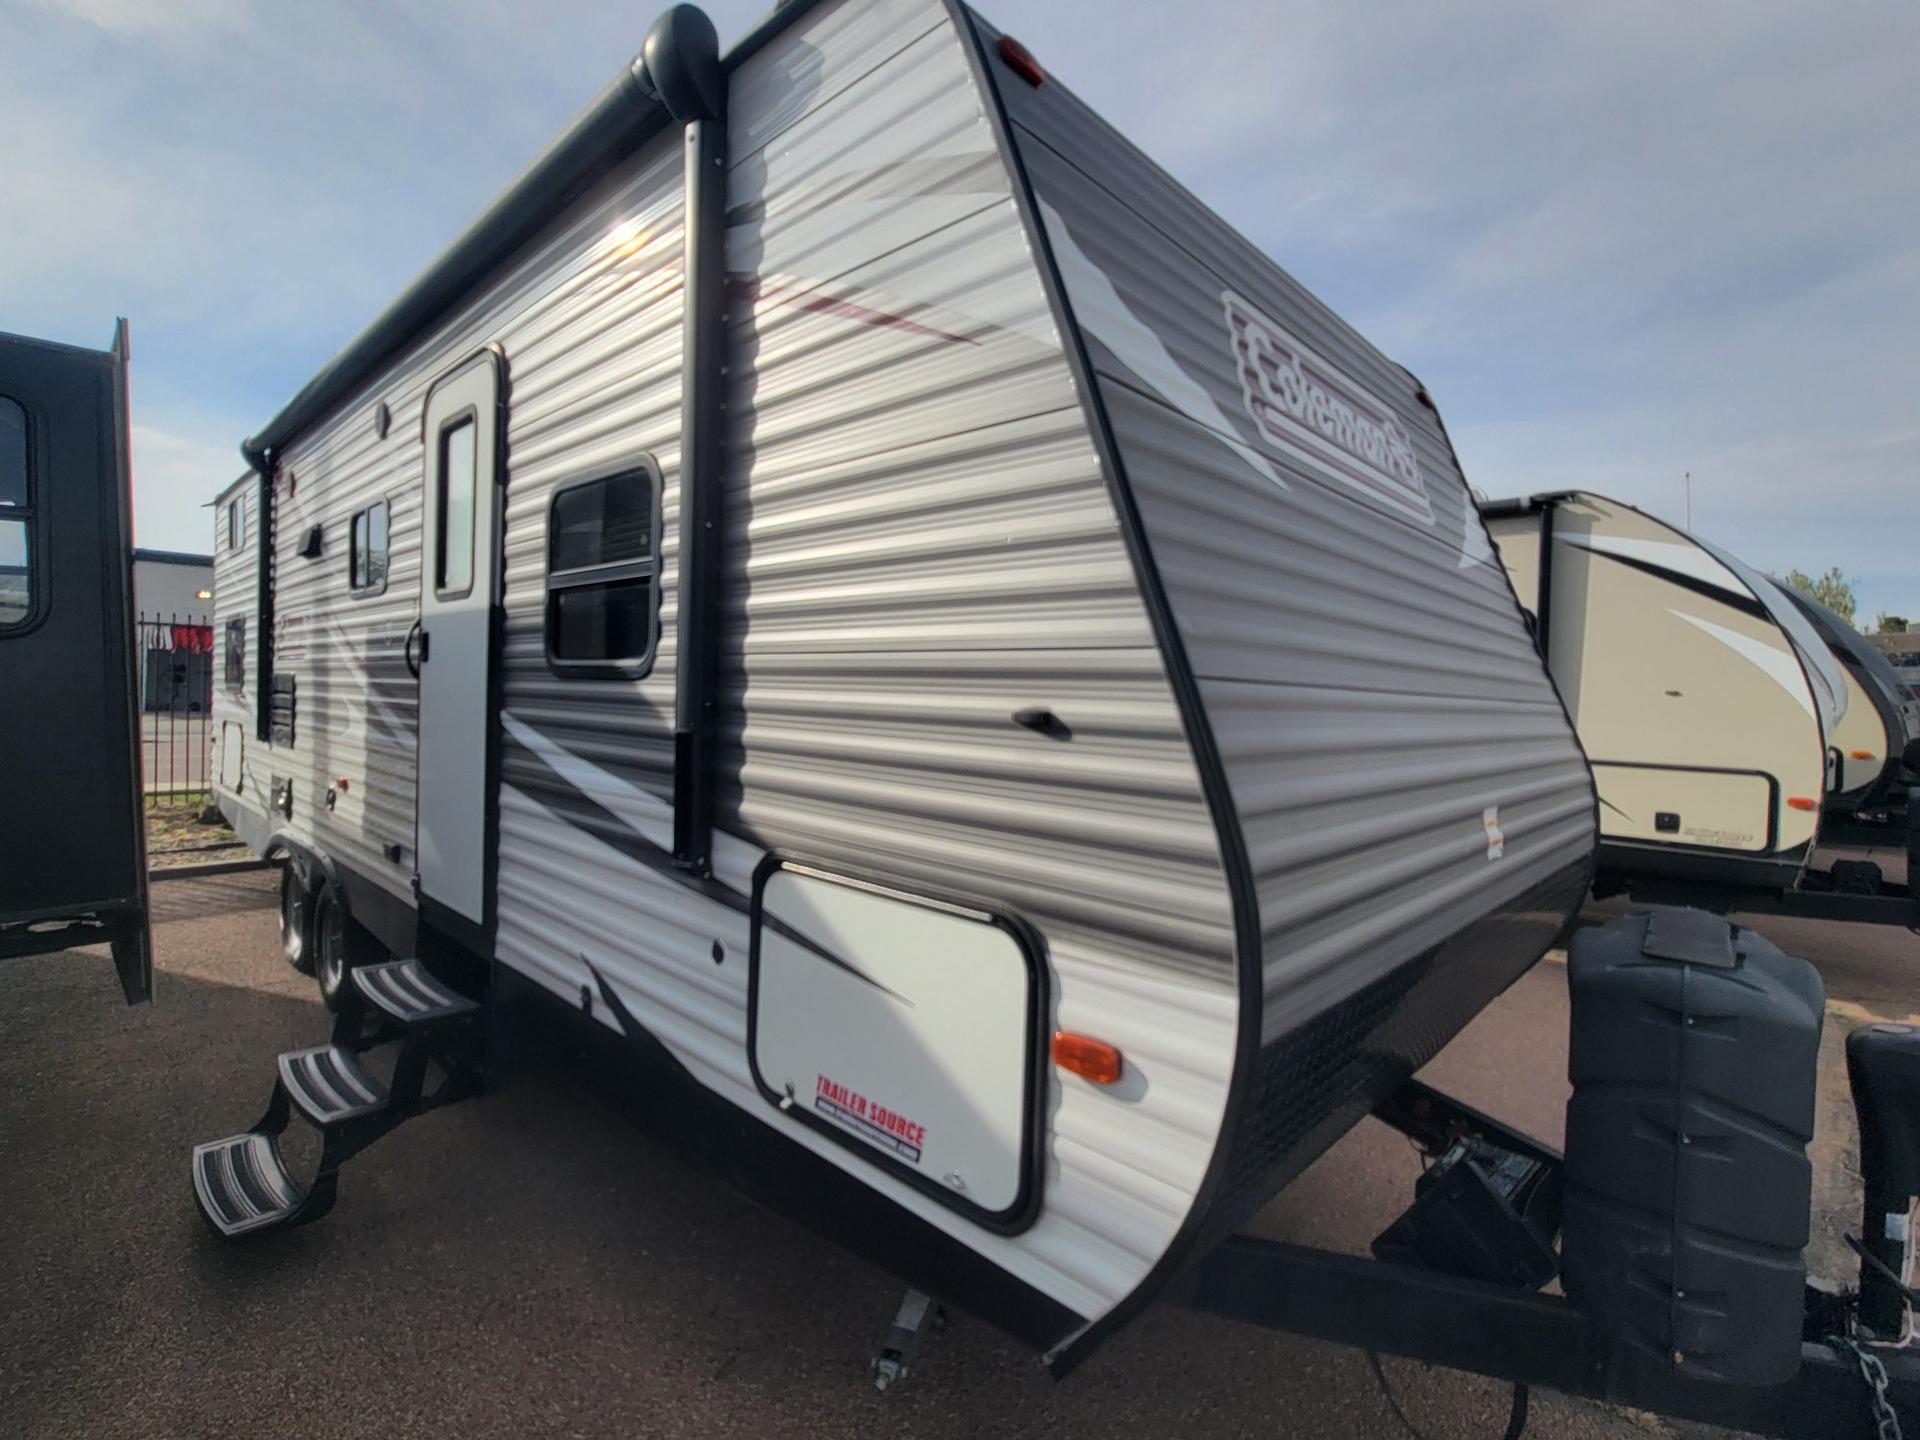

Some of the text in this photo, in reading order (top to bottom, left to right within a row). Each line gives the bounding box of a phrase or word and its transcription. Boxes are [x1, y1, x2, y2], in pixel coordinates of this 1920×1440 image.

[1245, 321, 1396, 477] Coleman
[816, 1075, 927, 1145] TRAILER SOURCE
